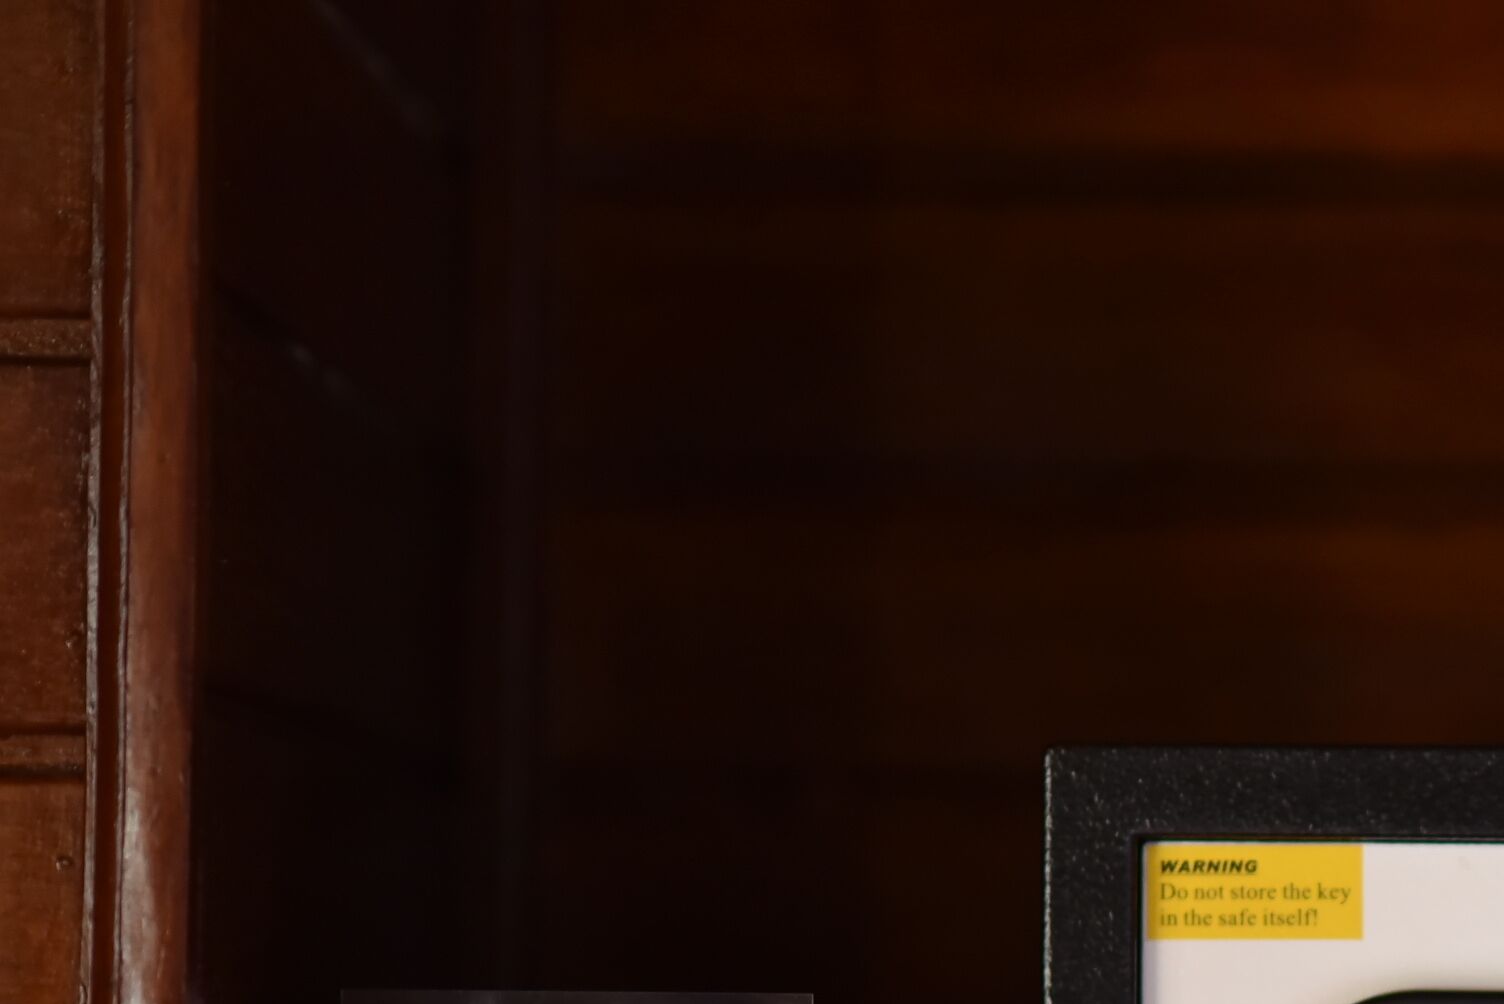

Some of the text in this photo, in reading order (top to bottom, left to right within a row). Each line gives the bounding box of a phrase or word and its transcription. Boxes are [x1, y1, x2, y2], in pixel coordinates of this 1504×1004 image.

[1160, 860, 1258, 874] WARNING
[1160, 883, 1351, 905] Do not store the key
[1160, 909, 1318, 926] in the safe itself!
